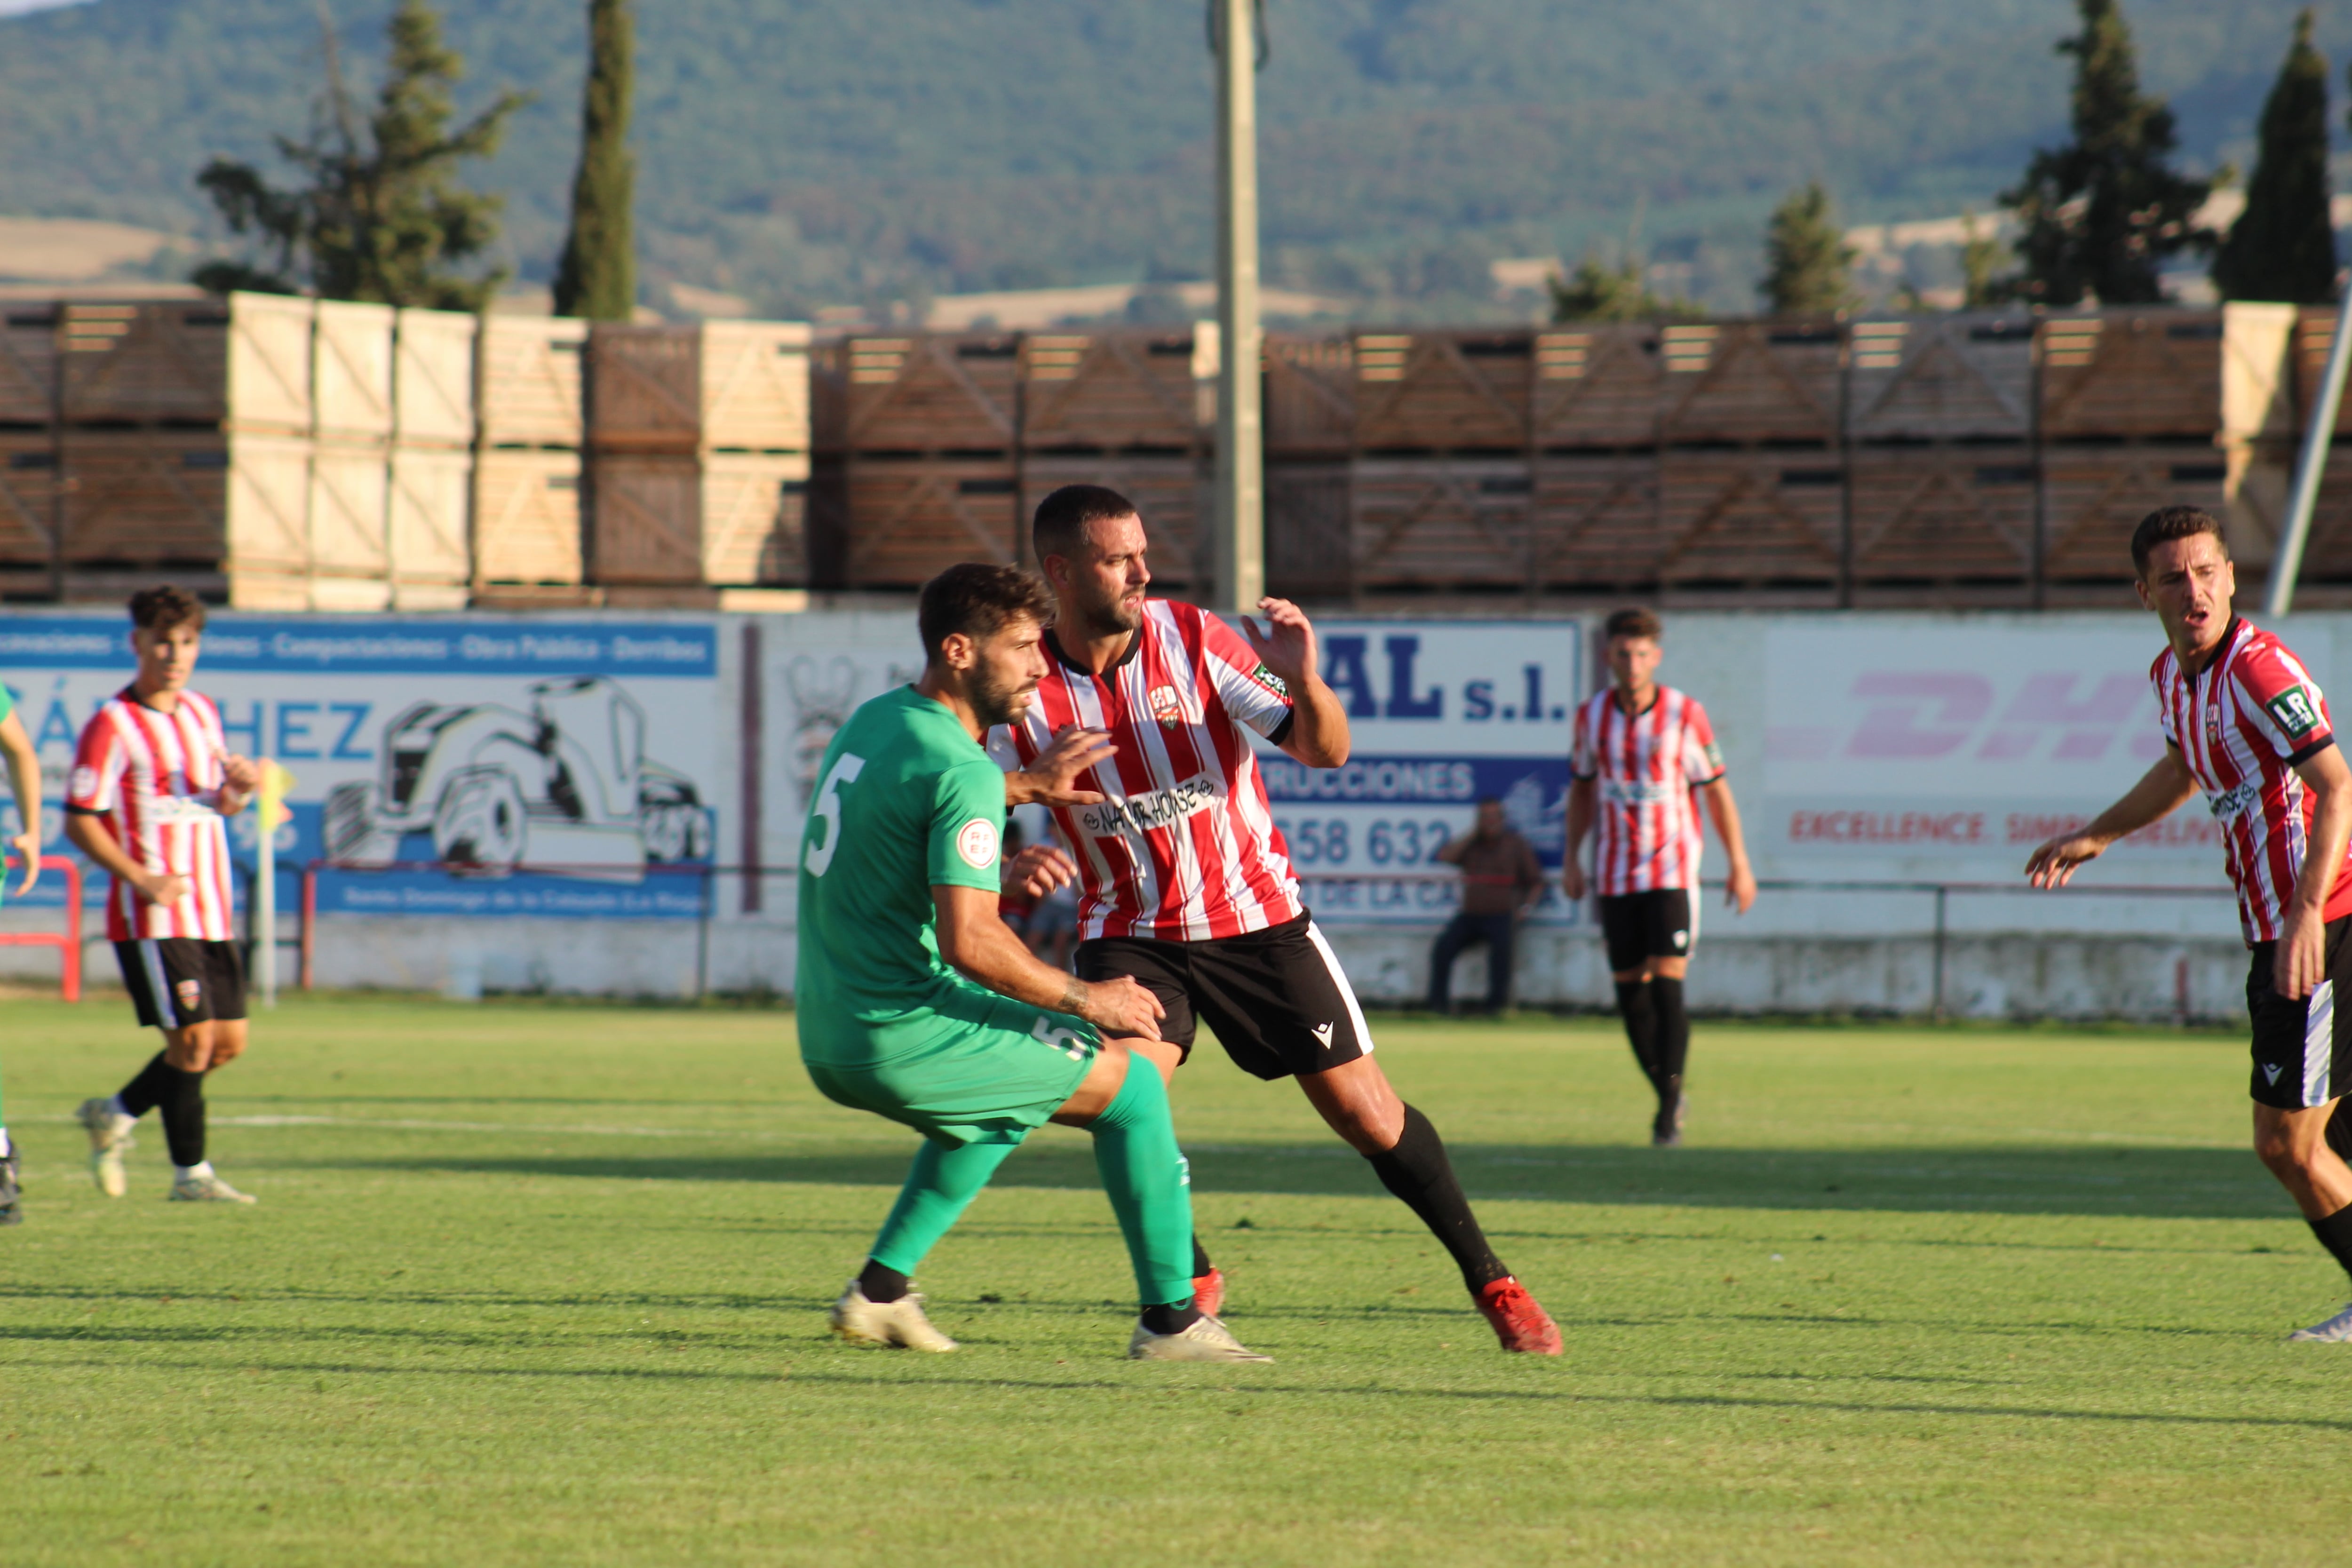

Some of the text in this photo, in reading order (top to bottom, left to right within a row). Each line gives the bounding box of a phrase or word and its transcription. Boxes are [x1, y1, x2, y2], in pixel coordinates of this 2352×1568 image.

[1324, 636, 1443, 719] AL
[2273, 692, 2309, 724] LR
[1846, 670, 2167, 761] DH
[804, 752, 867, 878] 5
[1367, 820, 1453, 866] 632
[1031, 1015, 1088, 1062] 5
